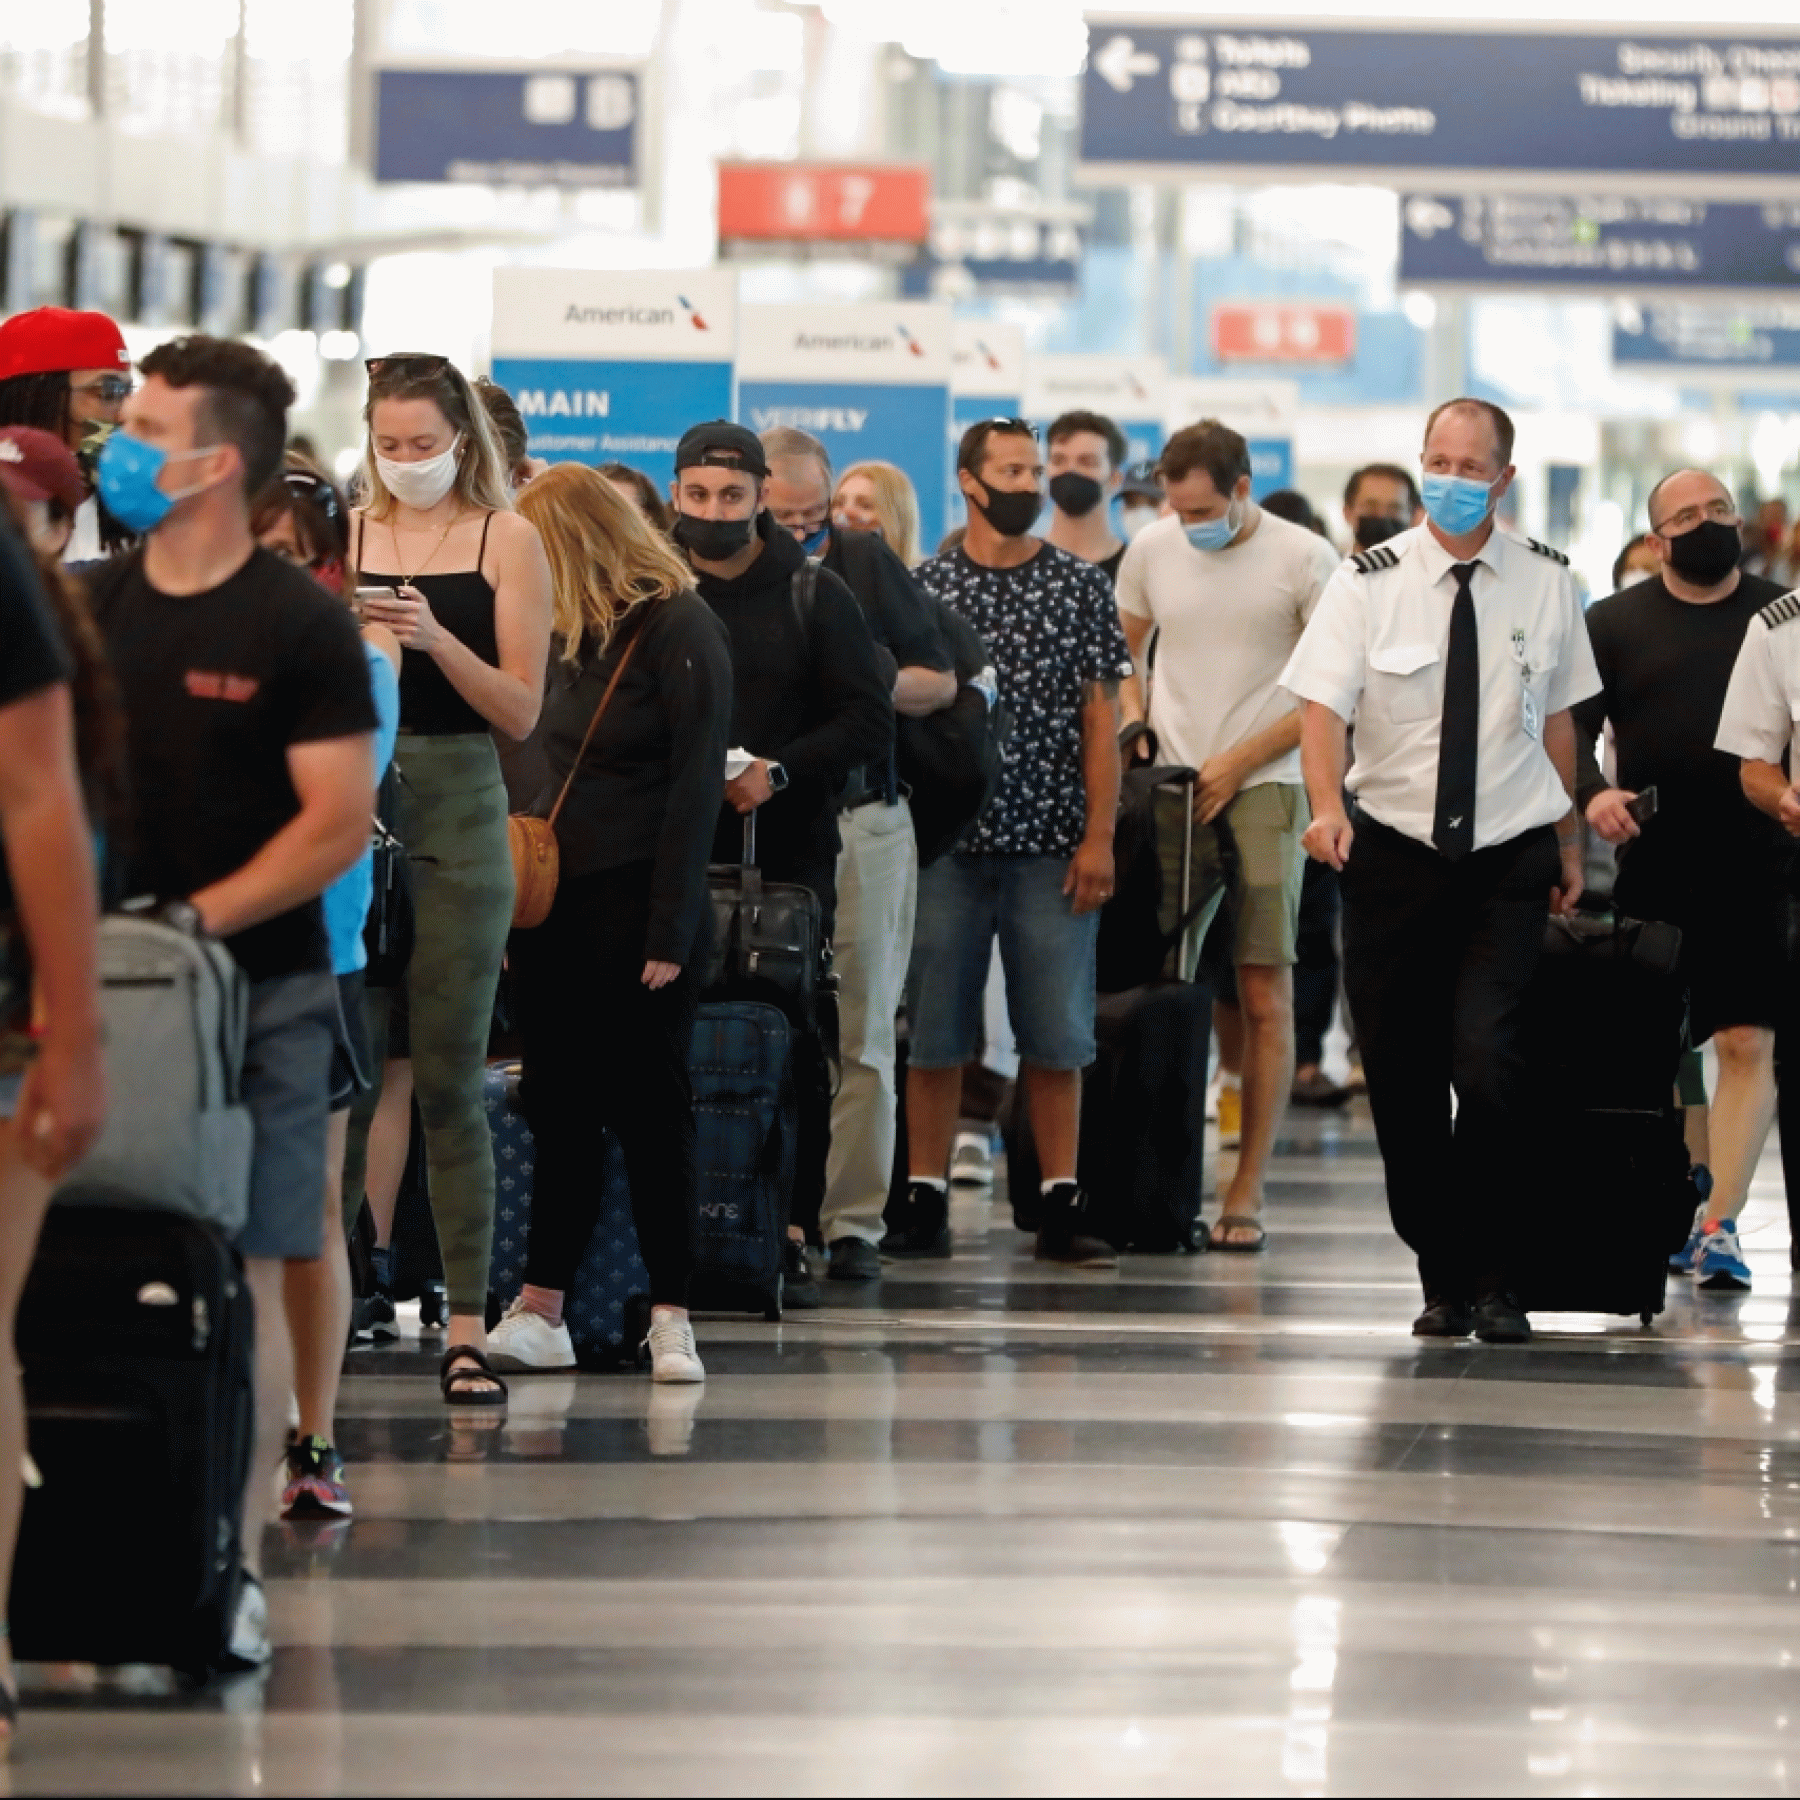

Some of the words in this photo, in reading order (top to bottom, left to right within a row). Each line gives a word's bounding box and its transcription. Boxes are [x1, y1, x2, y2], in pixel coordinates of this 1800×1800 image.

[565, 304, 675, 324] American
[795, 333, 894, 352] American
[517, 389, 609, 417] MAIN
[527, 434, 596, 451] ustomer
[603, 434, 681, 453] Assistanc
